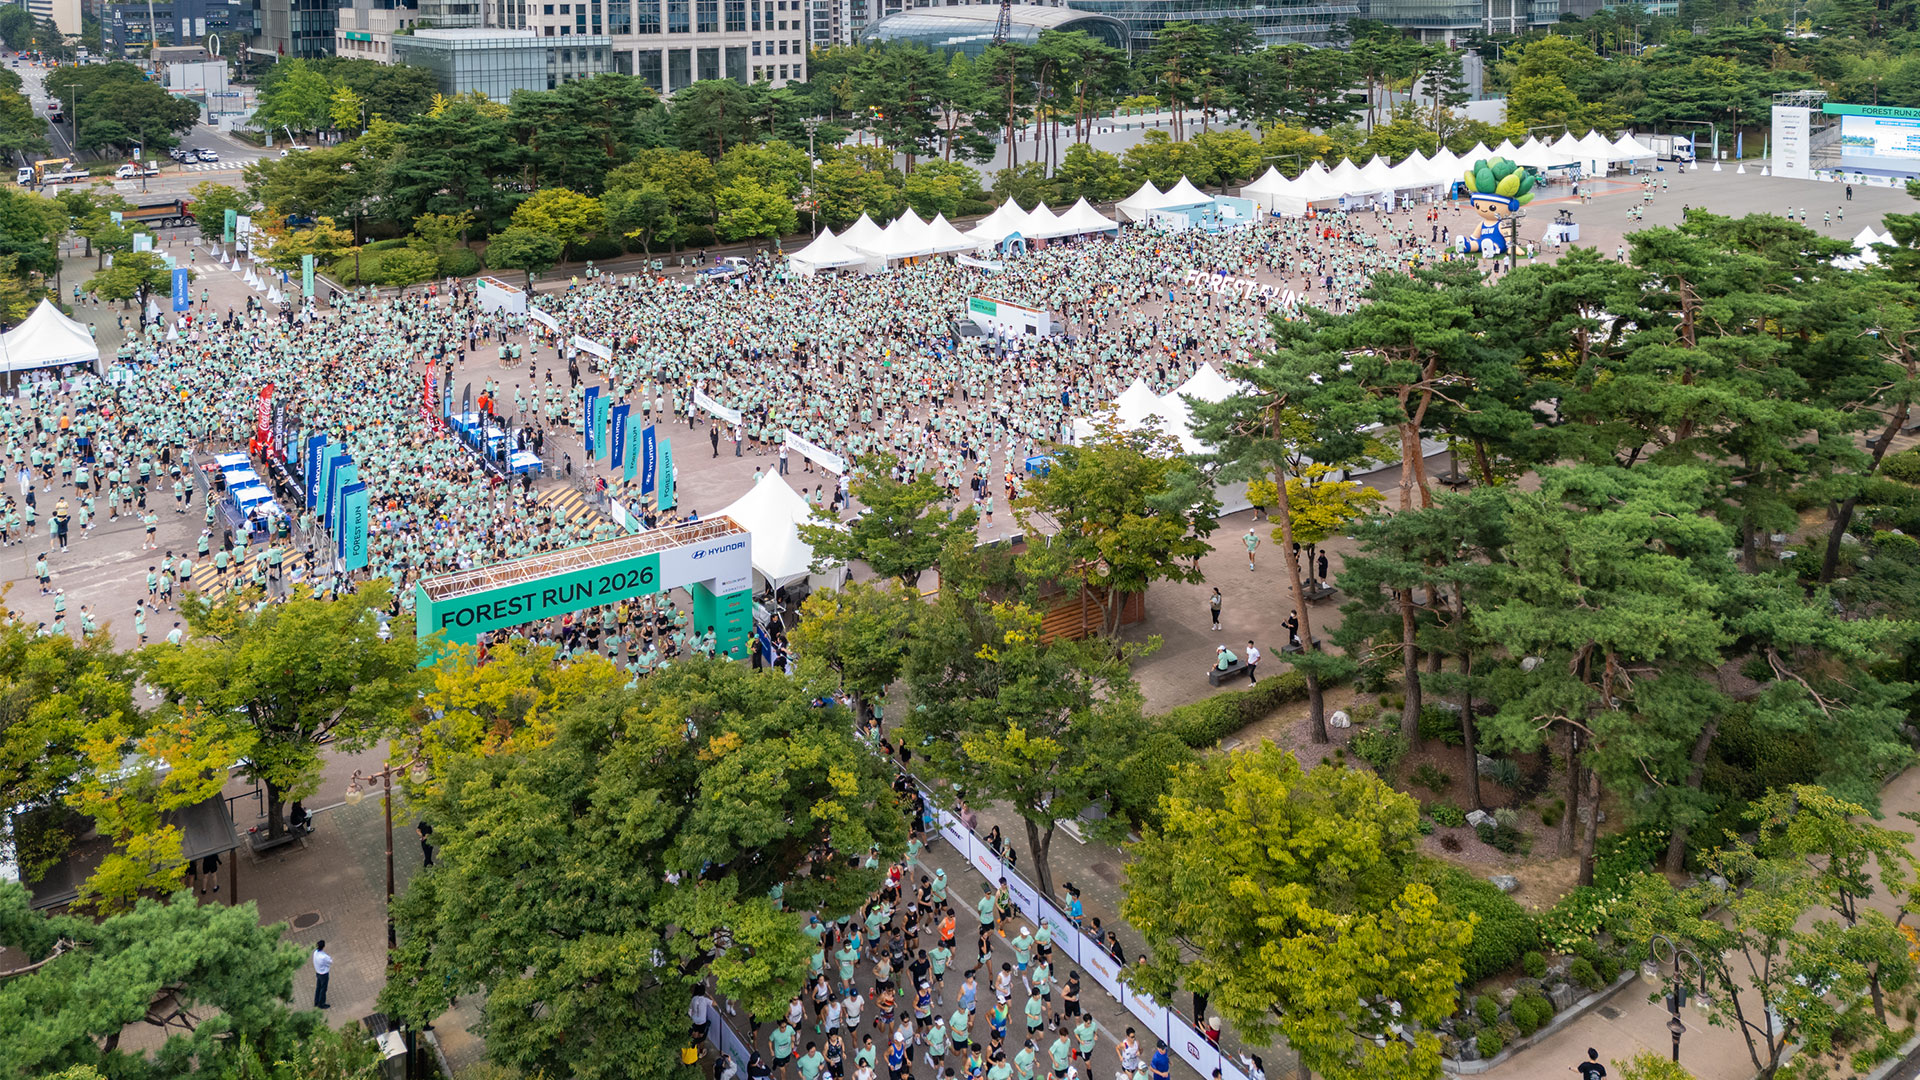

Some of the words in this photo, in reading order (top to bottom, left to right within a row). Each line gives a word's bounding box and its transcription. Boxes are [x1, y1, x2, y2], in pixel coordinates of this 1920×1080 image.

[1862, 107, 1893, 115] FOREST
[353, 523, 361, 556] FOREST
[708, 541, 746, 556] HYUNDAI
[441, 593, 536, 628] FOREST
[542, 580, 593, 608] RUN
[598, 566, 654, 596] 2026
